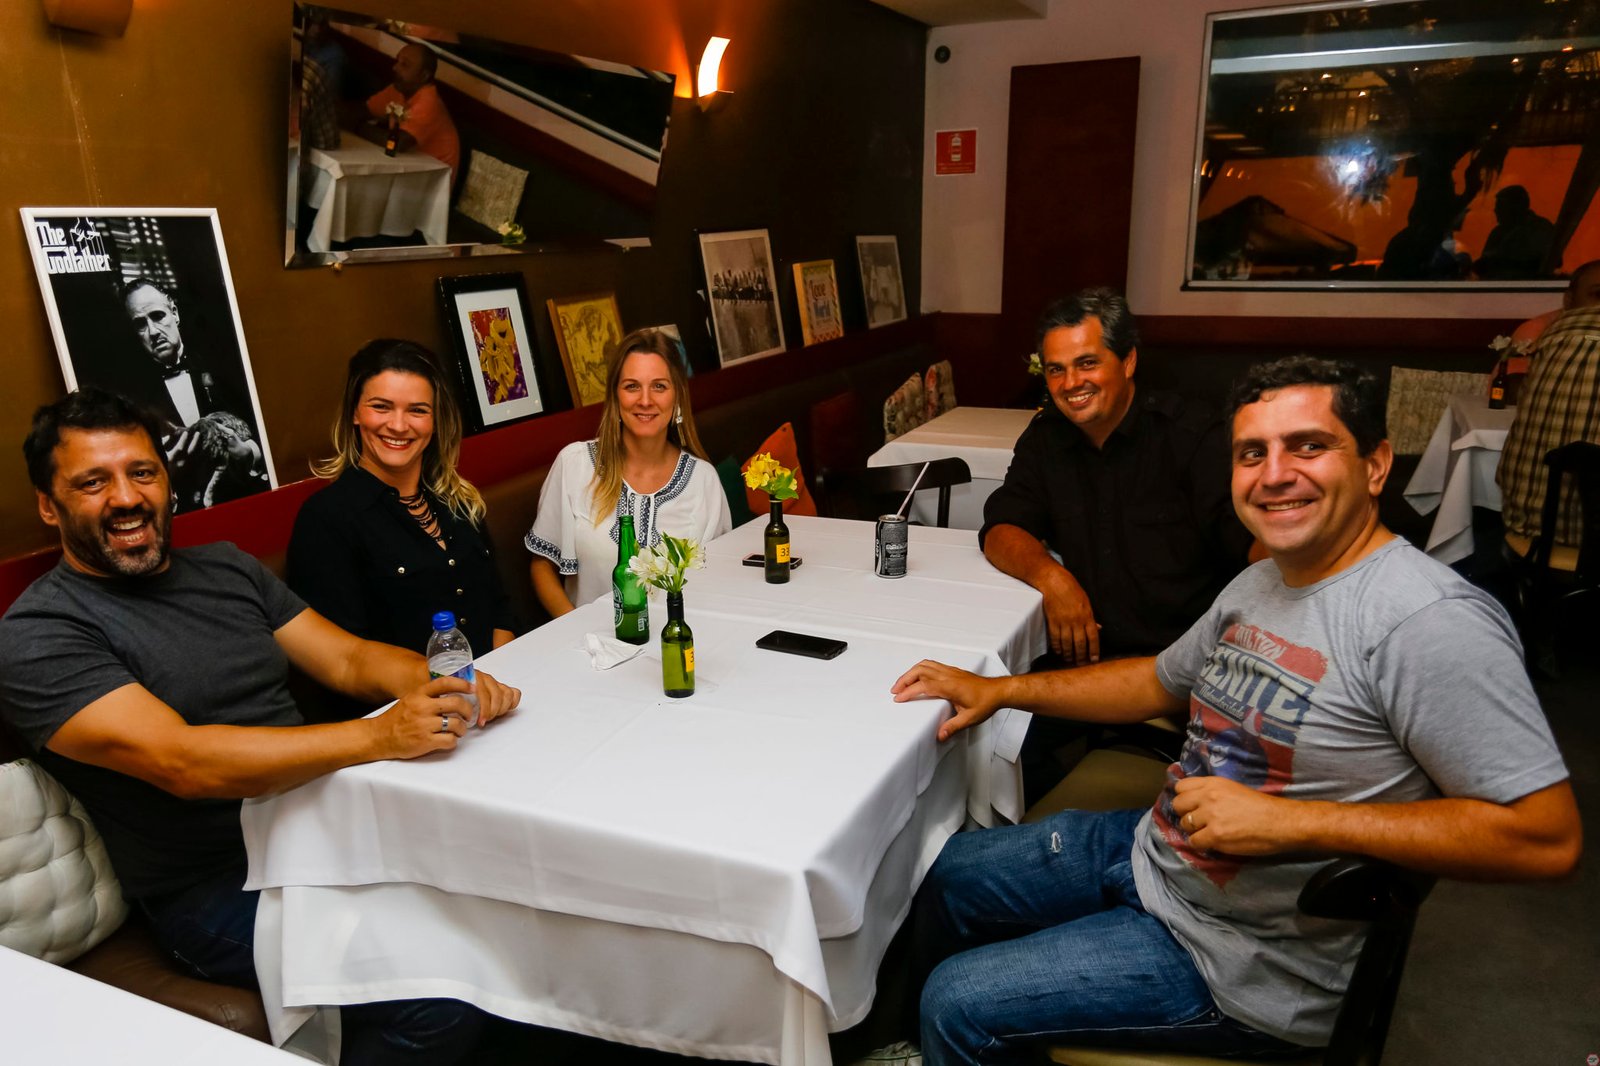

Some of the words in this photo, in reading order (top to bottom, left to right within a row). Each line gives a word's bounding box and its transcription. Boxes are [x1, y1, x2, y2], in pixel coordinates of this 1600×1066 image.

[35, 221, 67, 245] The
[42, 246, 111, 274] Godfather
[780, 548, 790, 557] 33
[1235, 626, 1287, 660] MILTON
